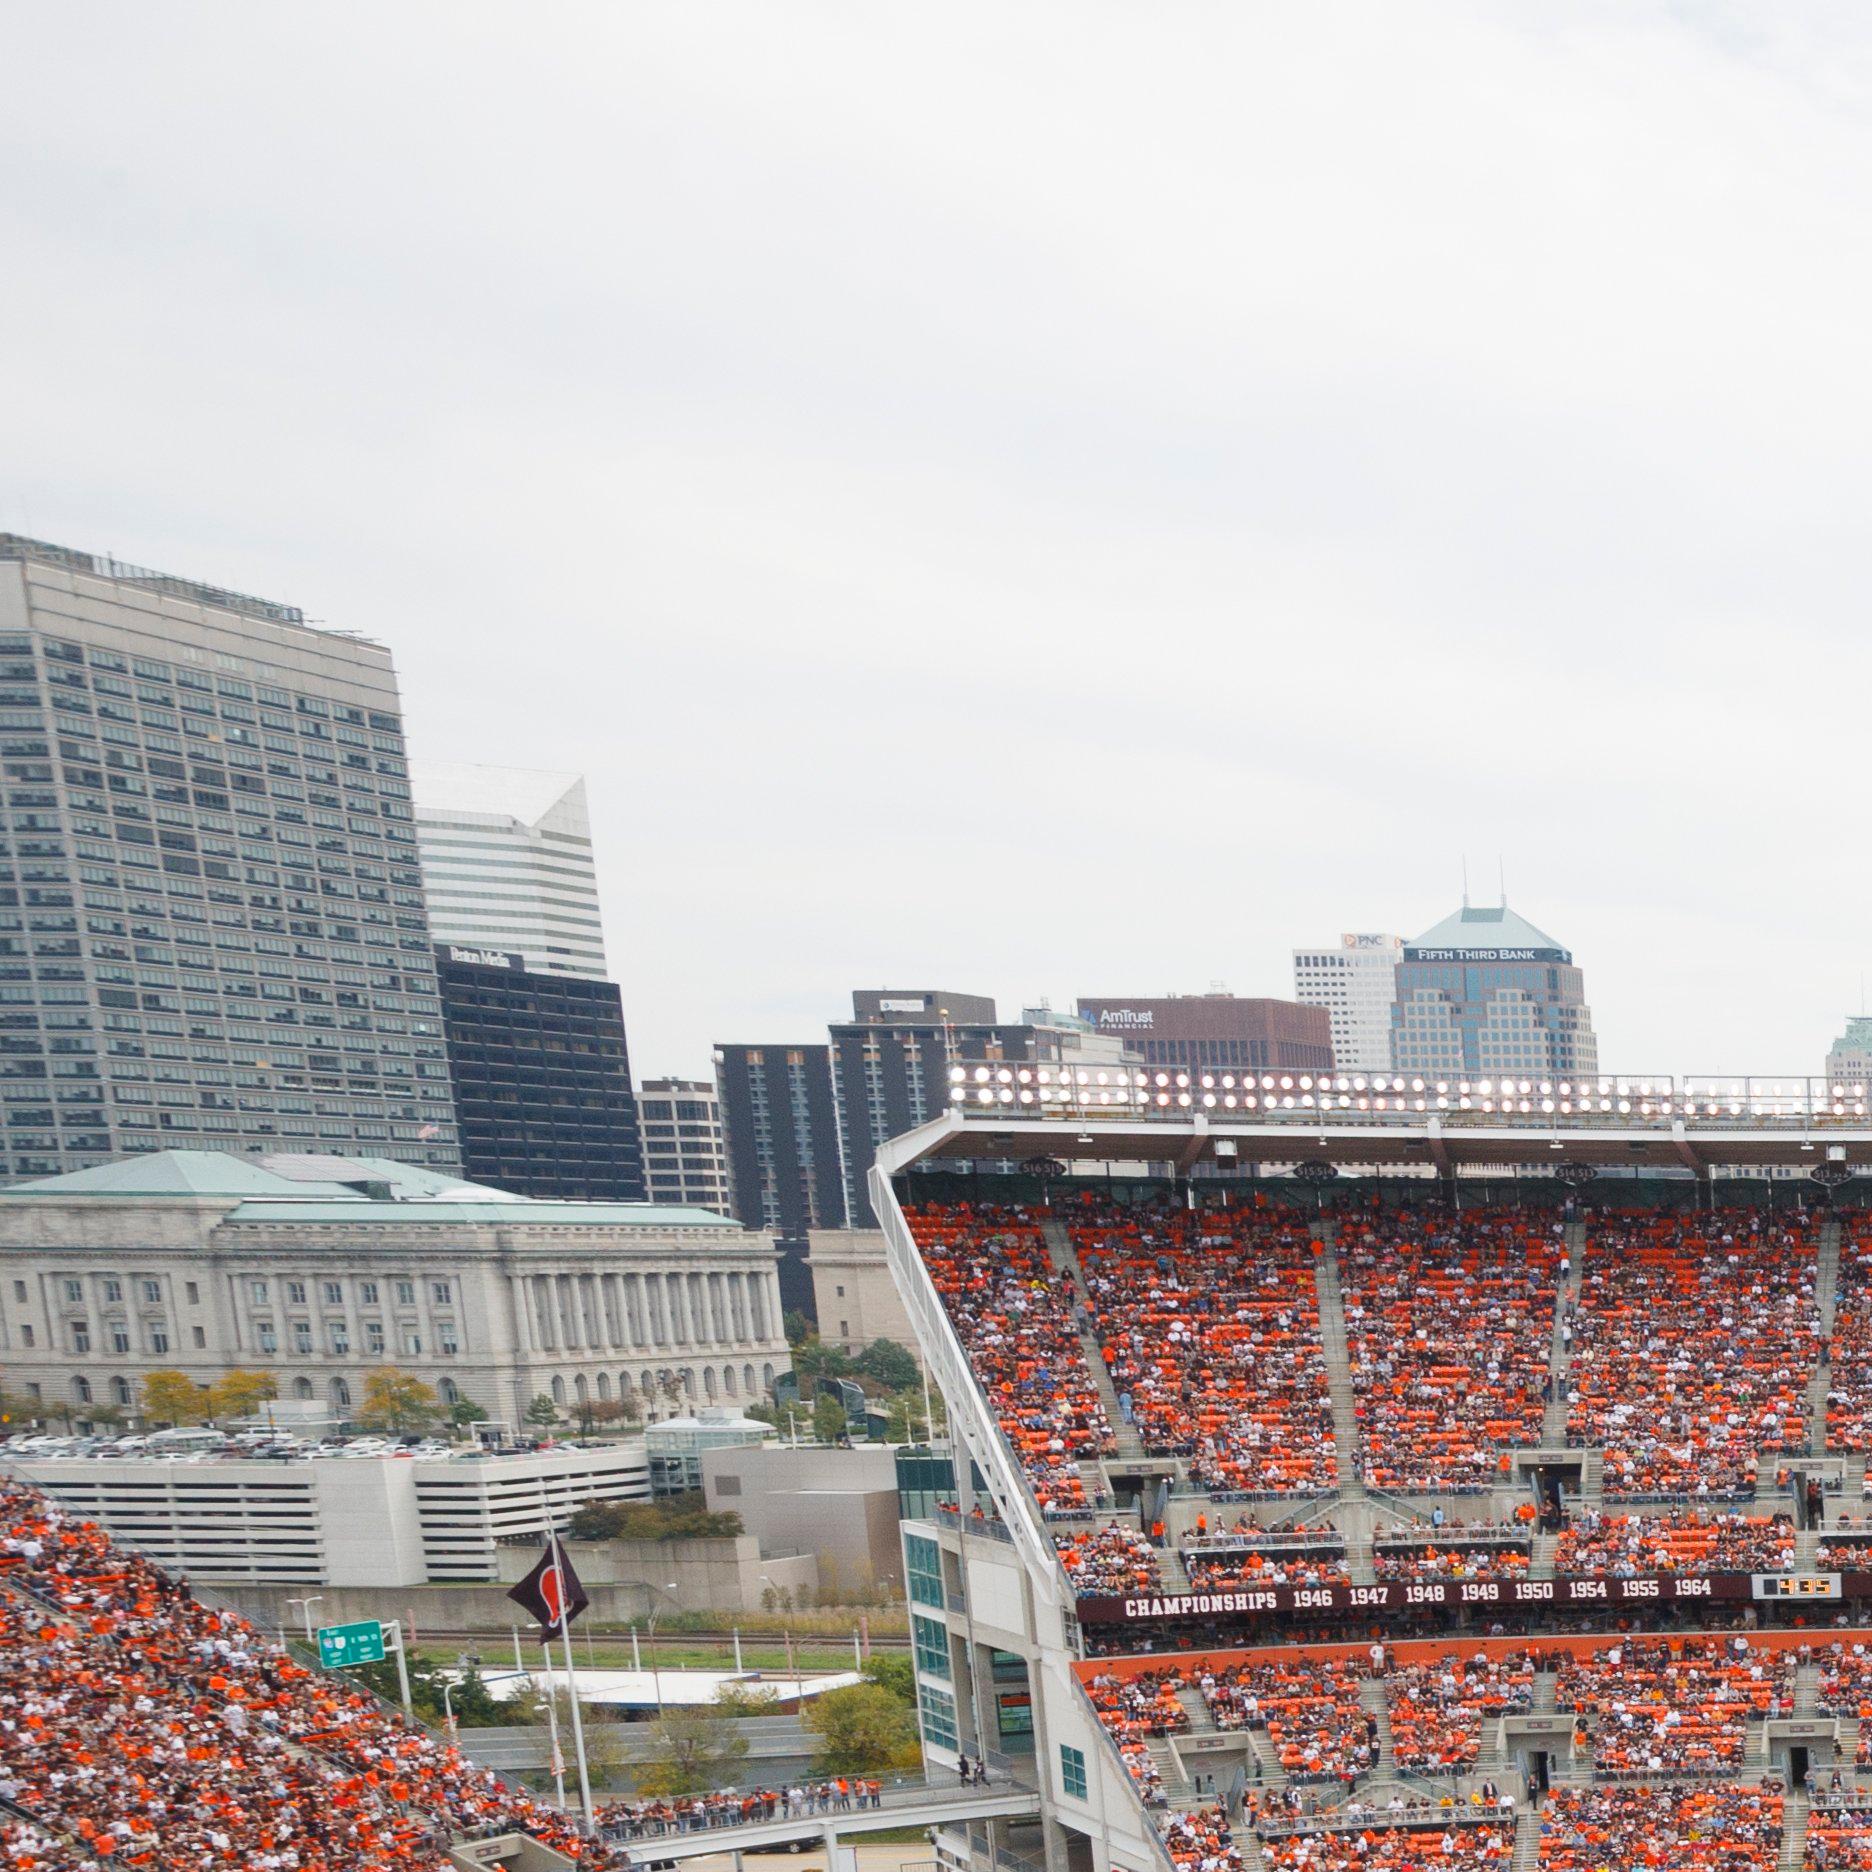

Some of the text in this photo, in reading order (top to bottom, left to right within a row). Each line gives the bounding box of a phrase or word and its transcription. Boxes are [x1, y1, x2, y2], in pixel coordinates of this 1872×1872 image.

[1418, 949, 1535, 960] FIFTH THIRD BANK
[1100, 1009, 1154, 1023] AmTrust
[1780, 1579, 1831, 1595] 4:35
[1125, 1579, 1711, 1617] CHAMPIONSHIPS 1946 1947 1948 1949 1950 1954 1955 1964
